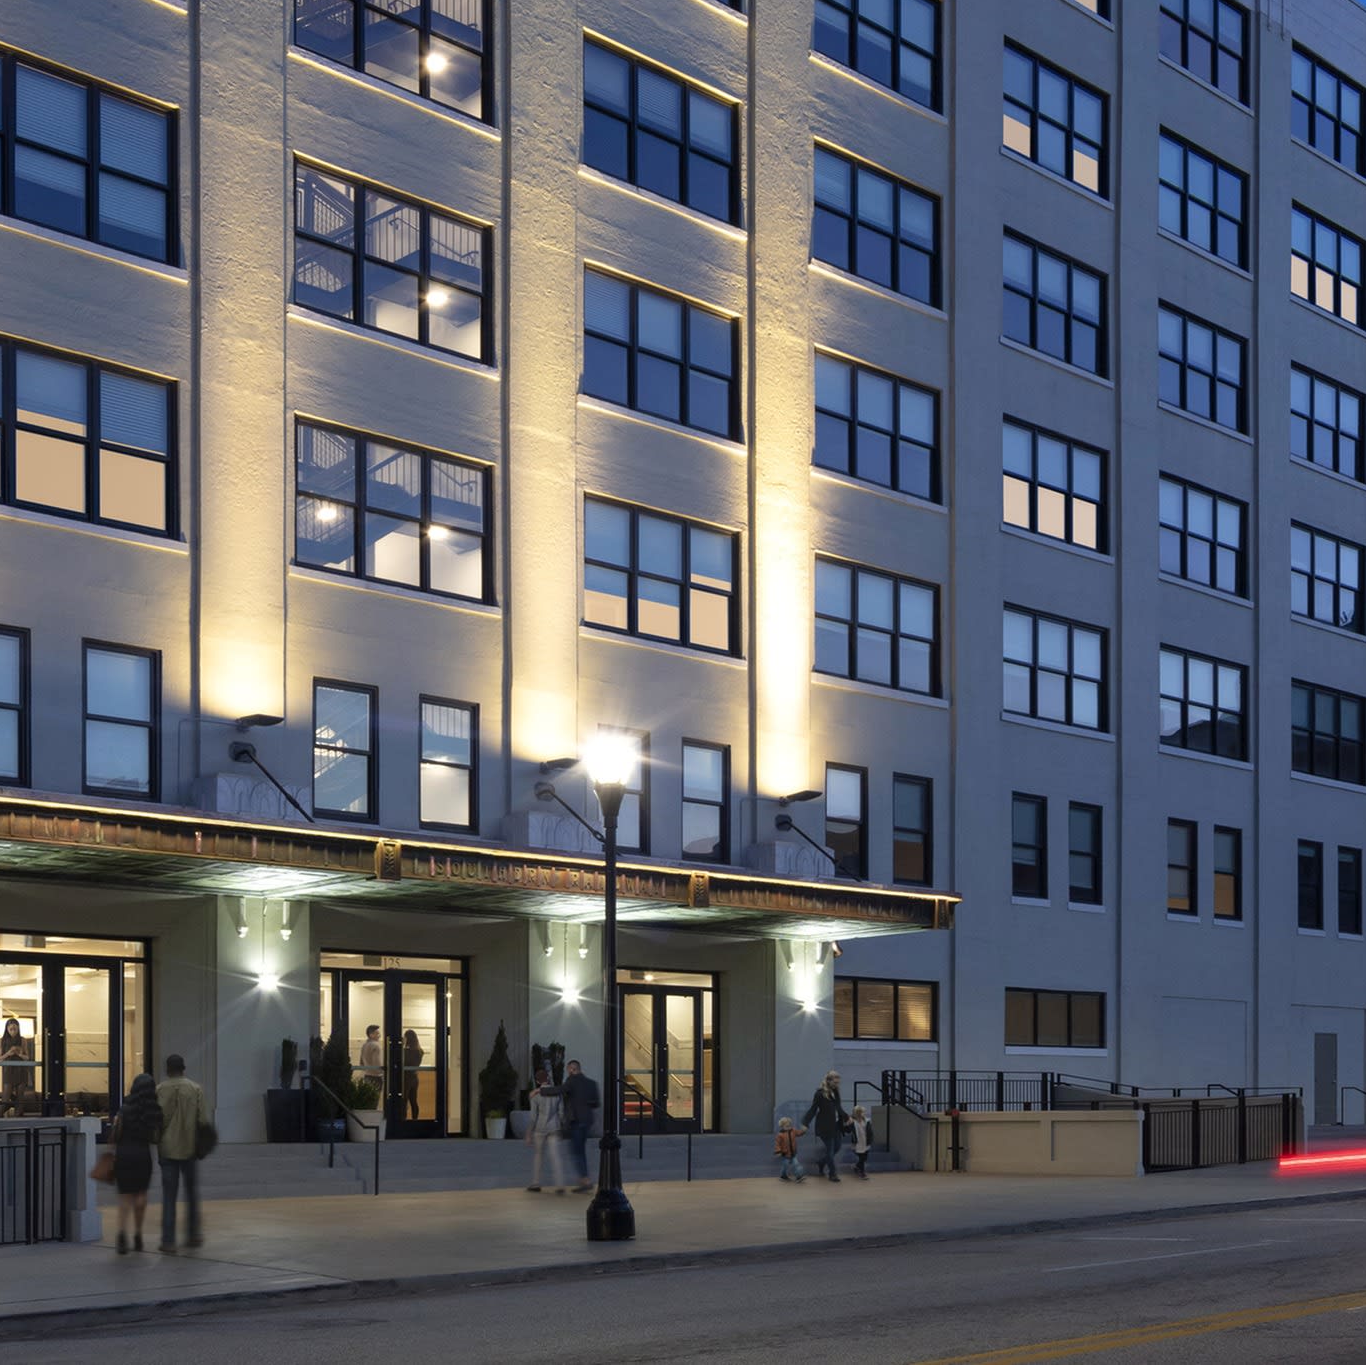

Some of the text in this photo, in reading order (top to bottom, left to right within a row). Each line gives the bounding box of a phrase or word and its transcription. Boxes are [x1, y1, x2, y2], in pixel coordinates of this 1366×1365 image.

[435, 859, 661, 896] SOUTHERN RAIWAY
[383, 957, 401, 969] 125
